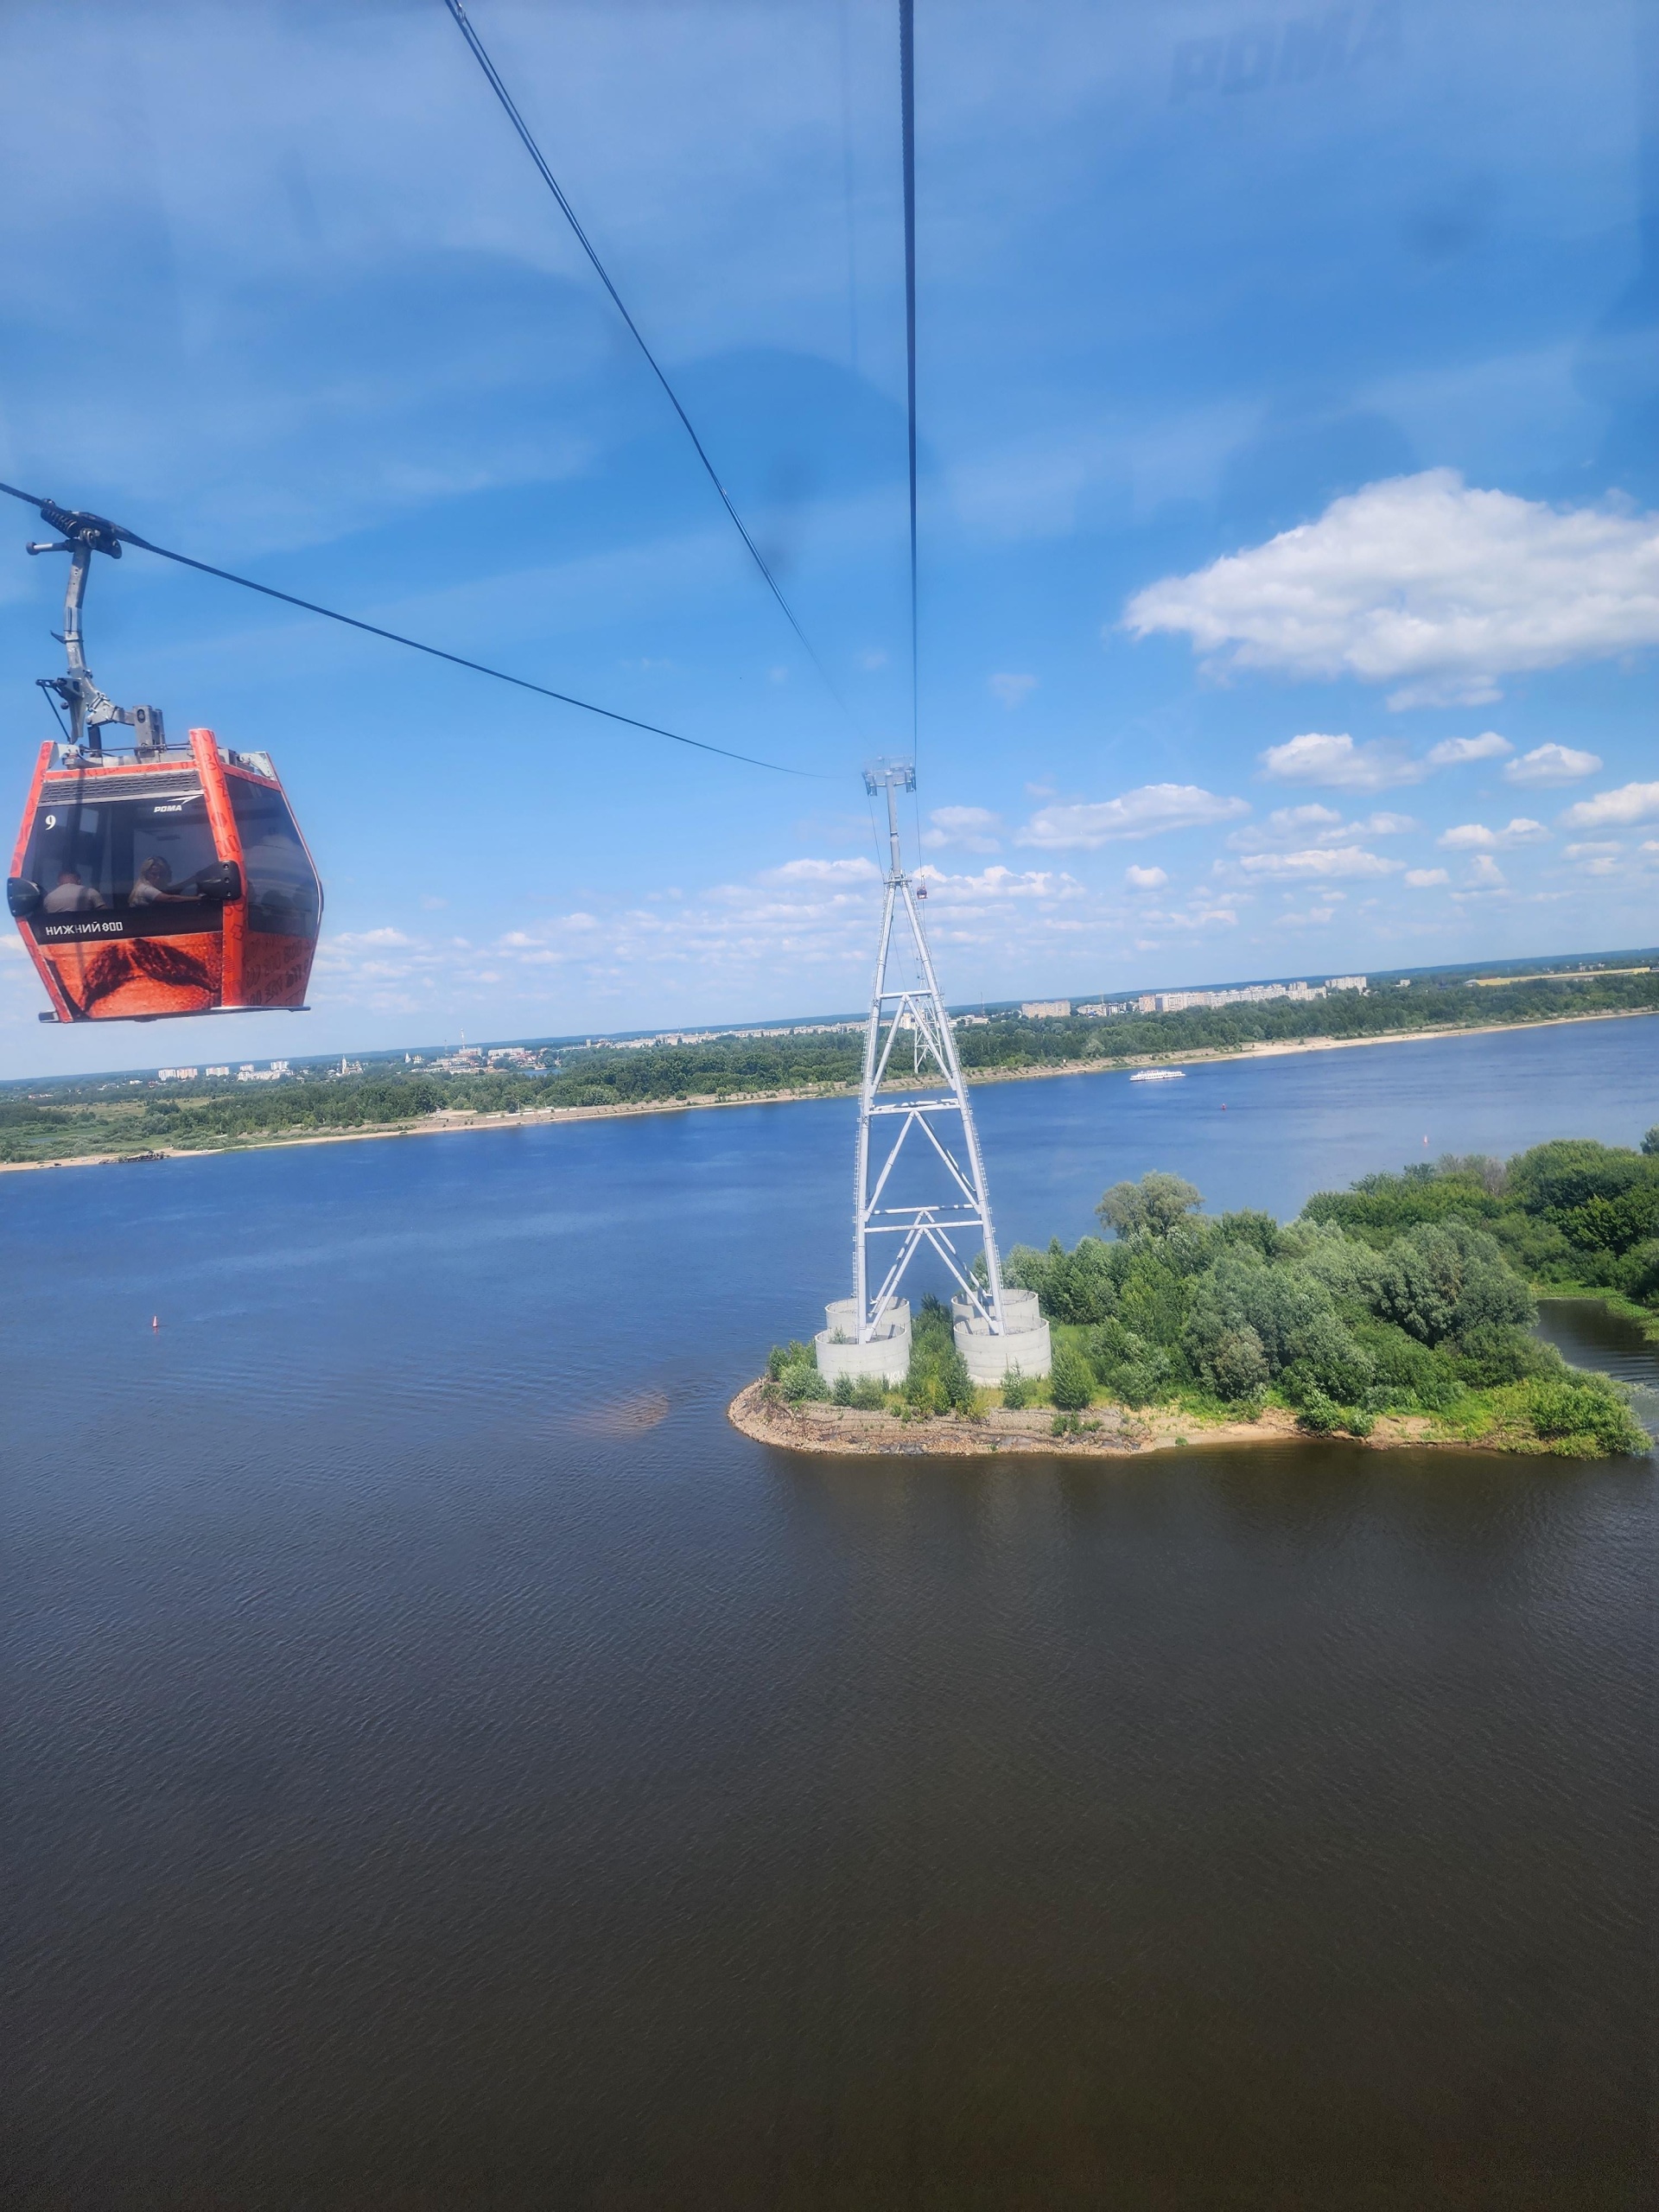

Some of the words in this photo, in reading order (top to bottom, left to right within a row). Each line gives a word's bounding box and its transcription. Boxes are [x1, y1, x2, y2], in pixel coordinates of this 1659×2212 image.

[1167, 0, 1403, 105] POMA
[45, 815, 56, 830] 9
[45, 921, 101, 936] НИЖНИЙ
